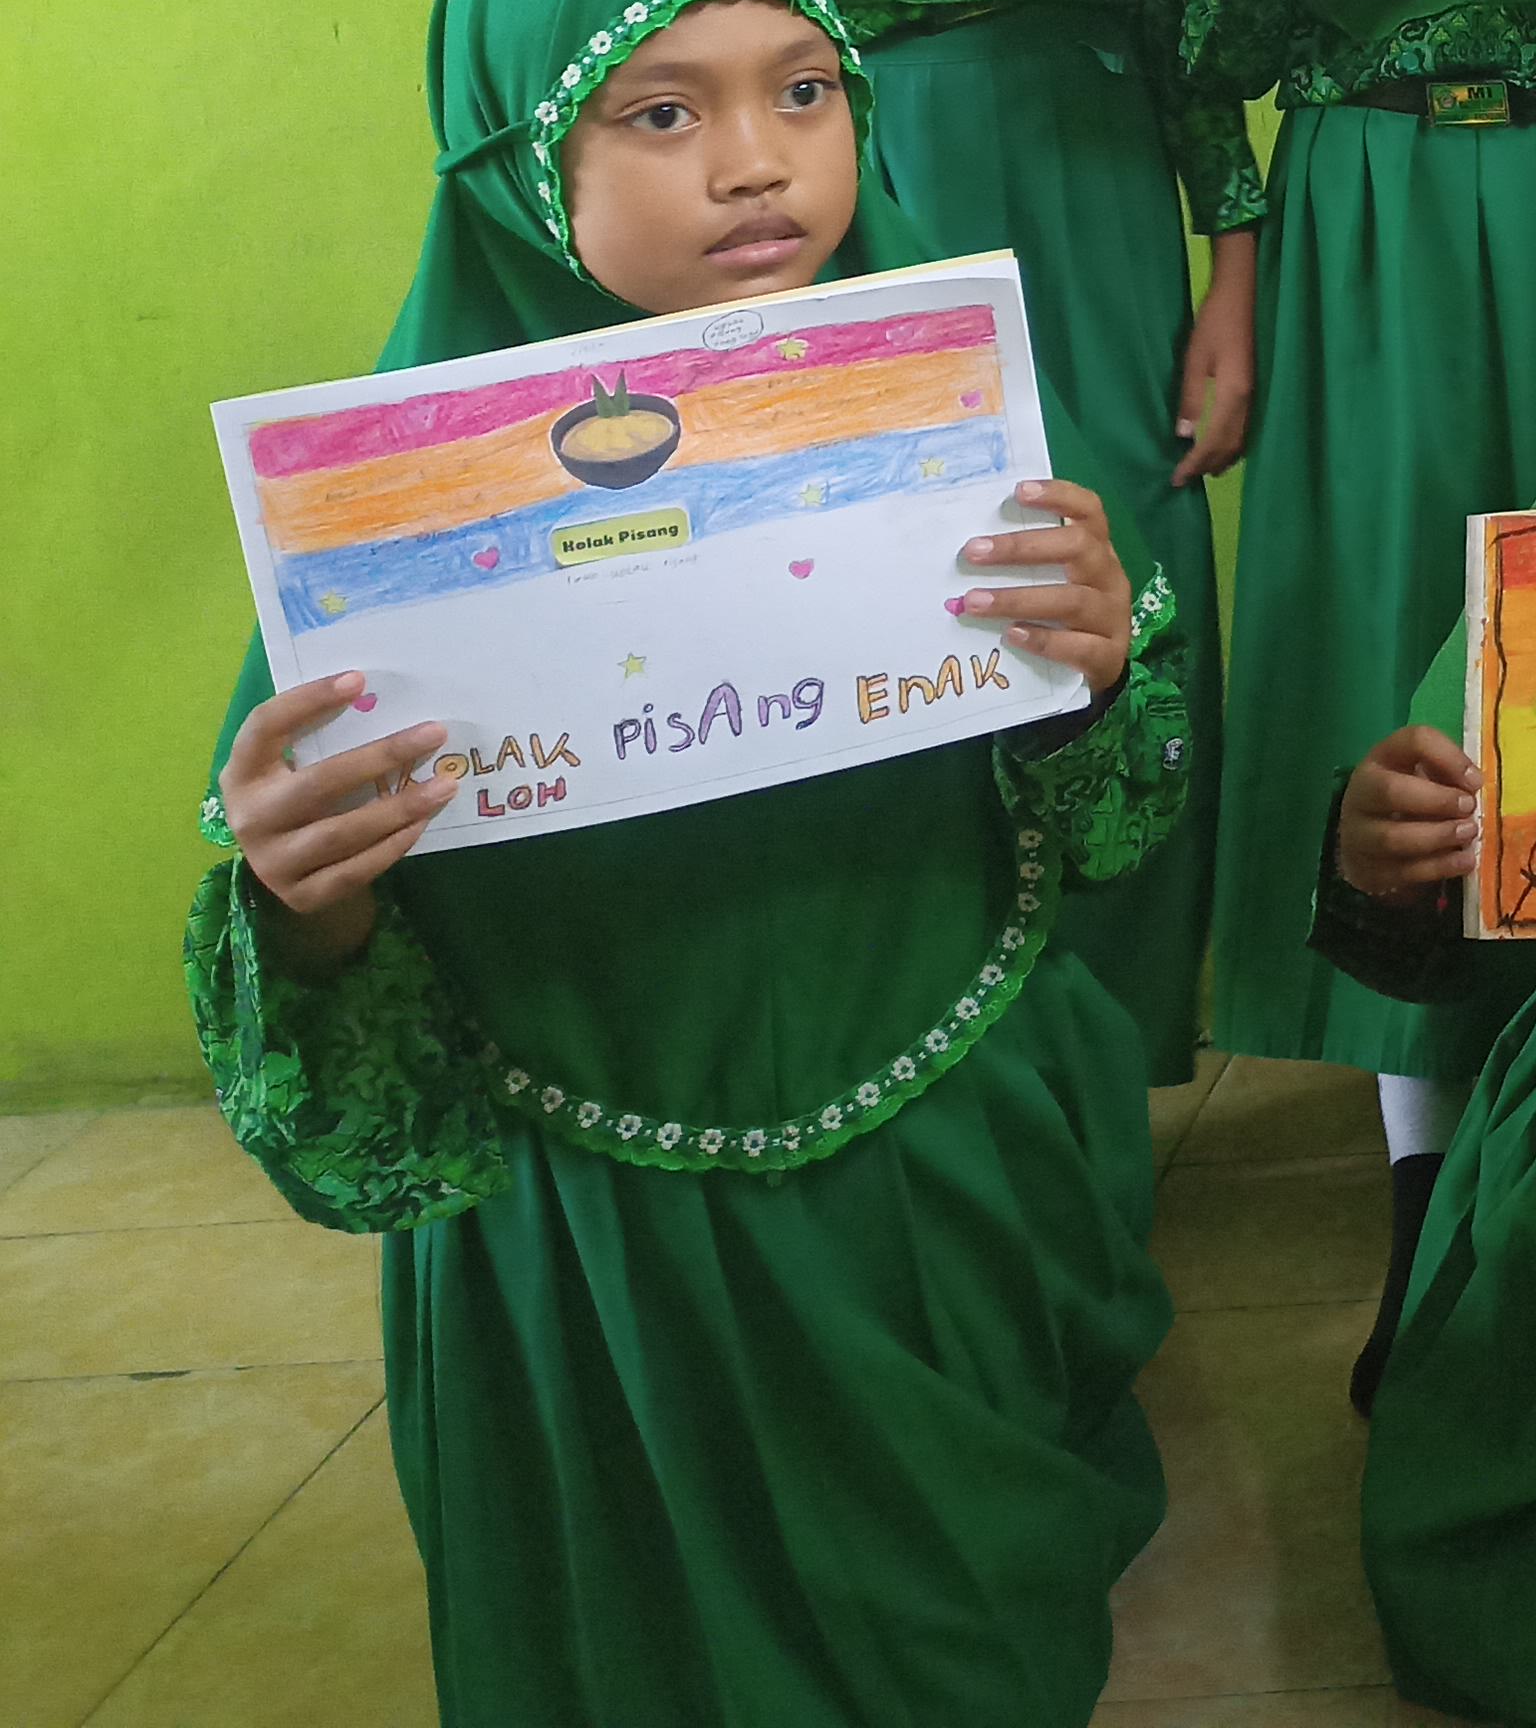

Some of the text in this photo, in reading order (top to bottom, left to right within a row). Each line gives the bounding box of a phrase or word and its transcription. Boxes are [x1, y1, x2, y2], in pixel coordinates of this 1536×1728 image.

[561, 524, 680, 554] Kolak Pisang
[476, 776, 568, 817] LOH
